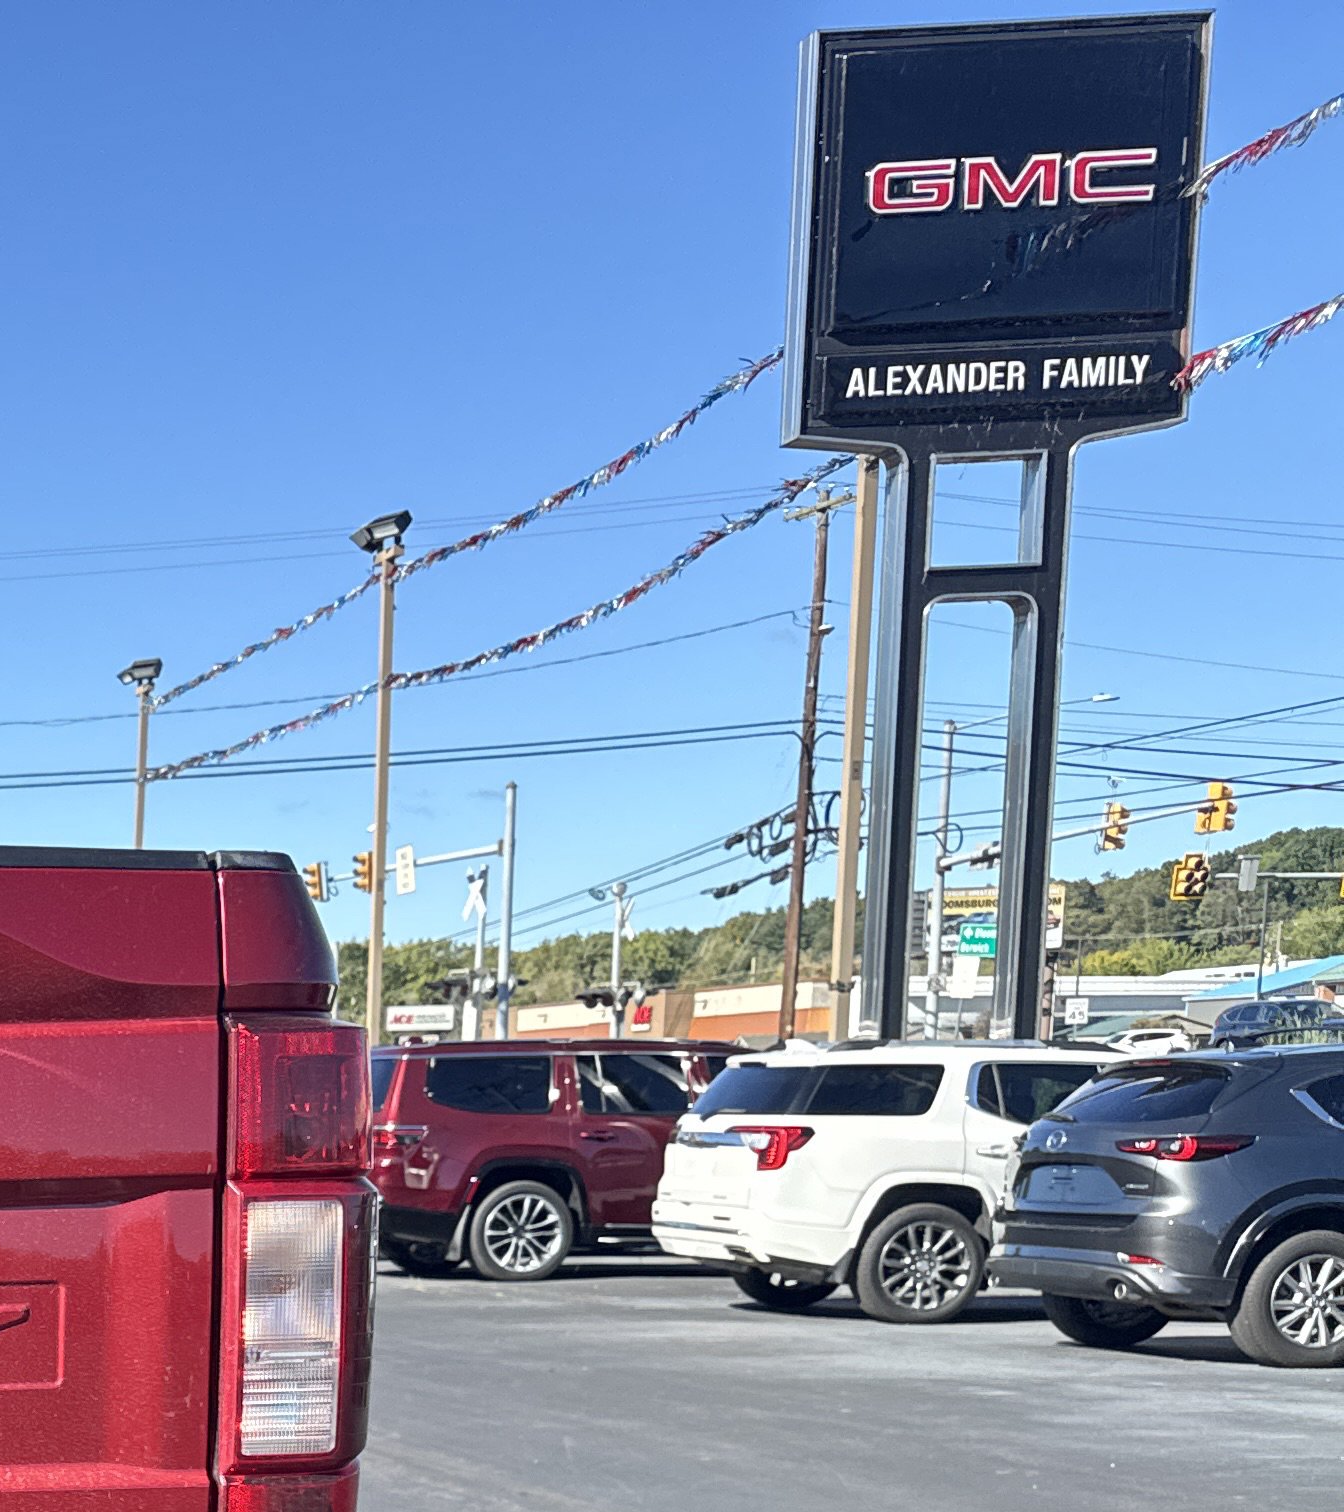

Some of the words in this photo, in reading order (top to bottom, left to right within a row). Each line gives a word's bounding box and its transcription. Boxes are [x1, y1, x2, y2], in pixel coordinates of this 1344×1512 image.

[866, 147, 1158, 215] GMC
[845, 360, 1026, 399] ALEXANDER
[1042, 354, 1151, 390] FAMILY
